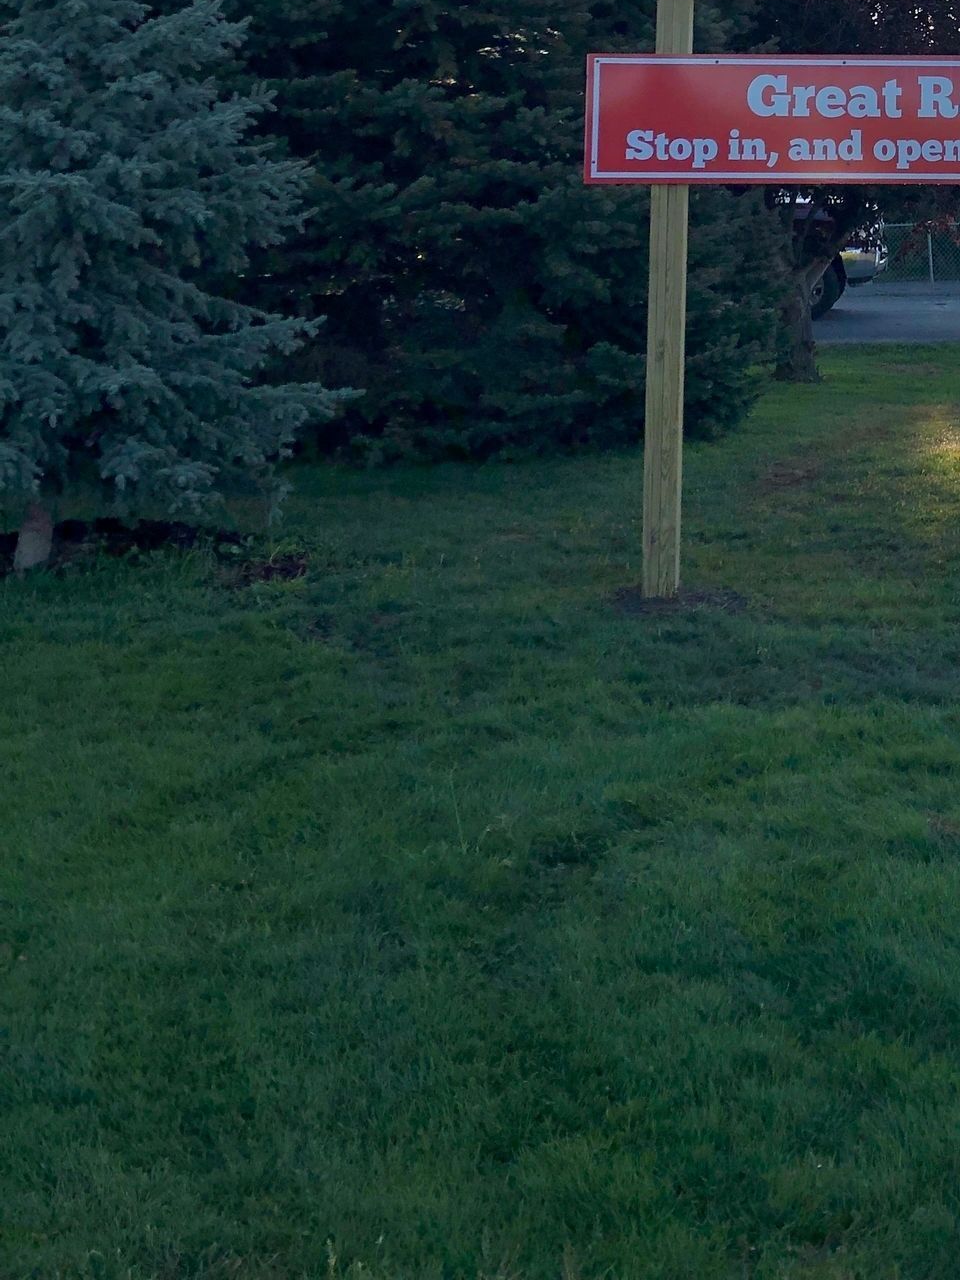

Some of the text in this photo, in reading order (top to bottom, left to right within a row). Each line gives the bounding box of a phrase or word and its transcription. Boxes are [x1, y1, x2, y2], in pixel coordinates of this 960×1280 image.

[746, 74, 901, 118] Great
[626, 129, 719, 168] Stop
[728, 130, 779, 166] in,
[789, 129, 863, 163] and
